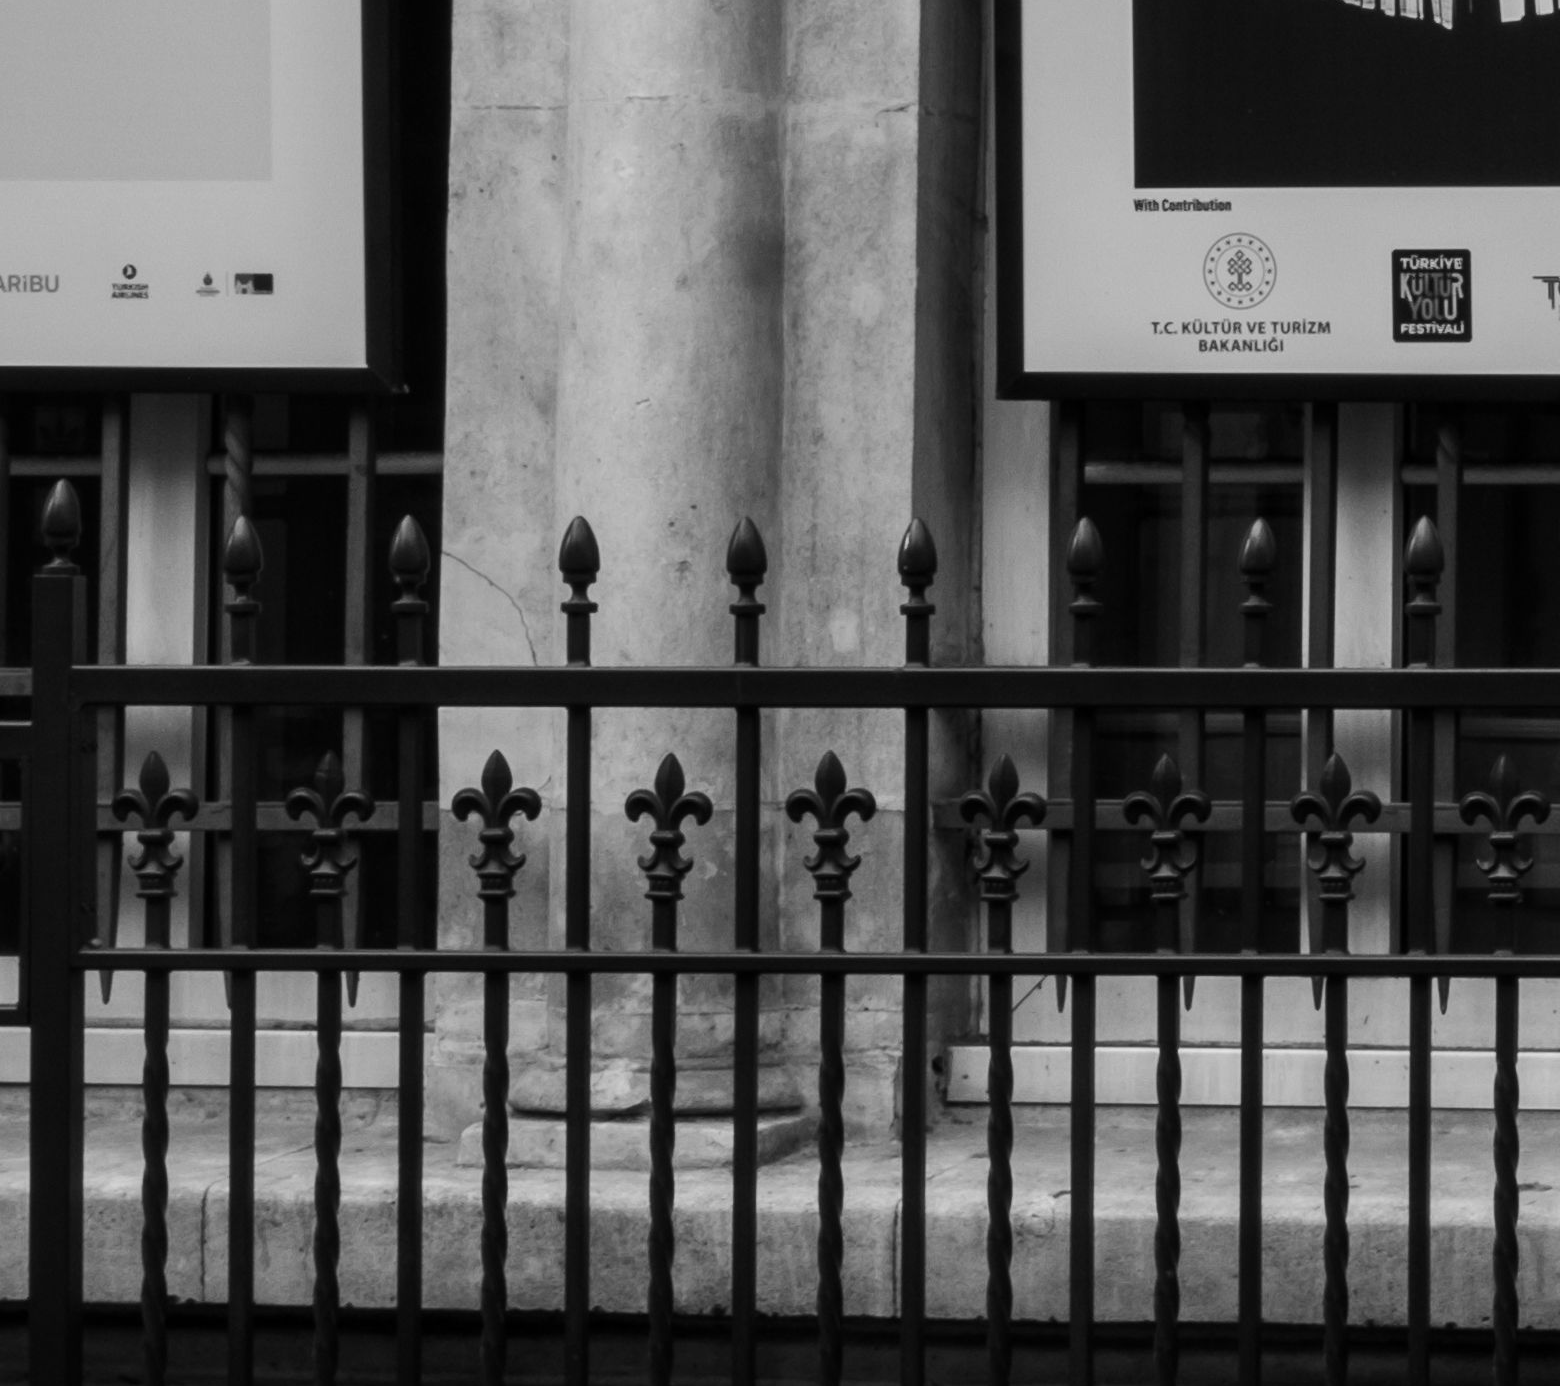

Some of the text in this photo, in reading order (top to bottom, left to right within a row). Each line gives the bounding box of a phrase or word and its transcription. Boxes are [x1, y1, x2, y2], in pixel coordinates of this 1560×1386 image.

[1134, 199, 1231, 211] With Contribution
[1400, 255, 1462, 270] TÜRKİYE
[1152, 318, 1330, 334] T.C. KÜLTÜR VE TURİZM
[1401, 321, 1464, 335] FESTİVALİ
[1198, 336, 1284, 353] BAKANLIĞI
